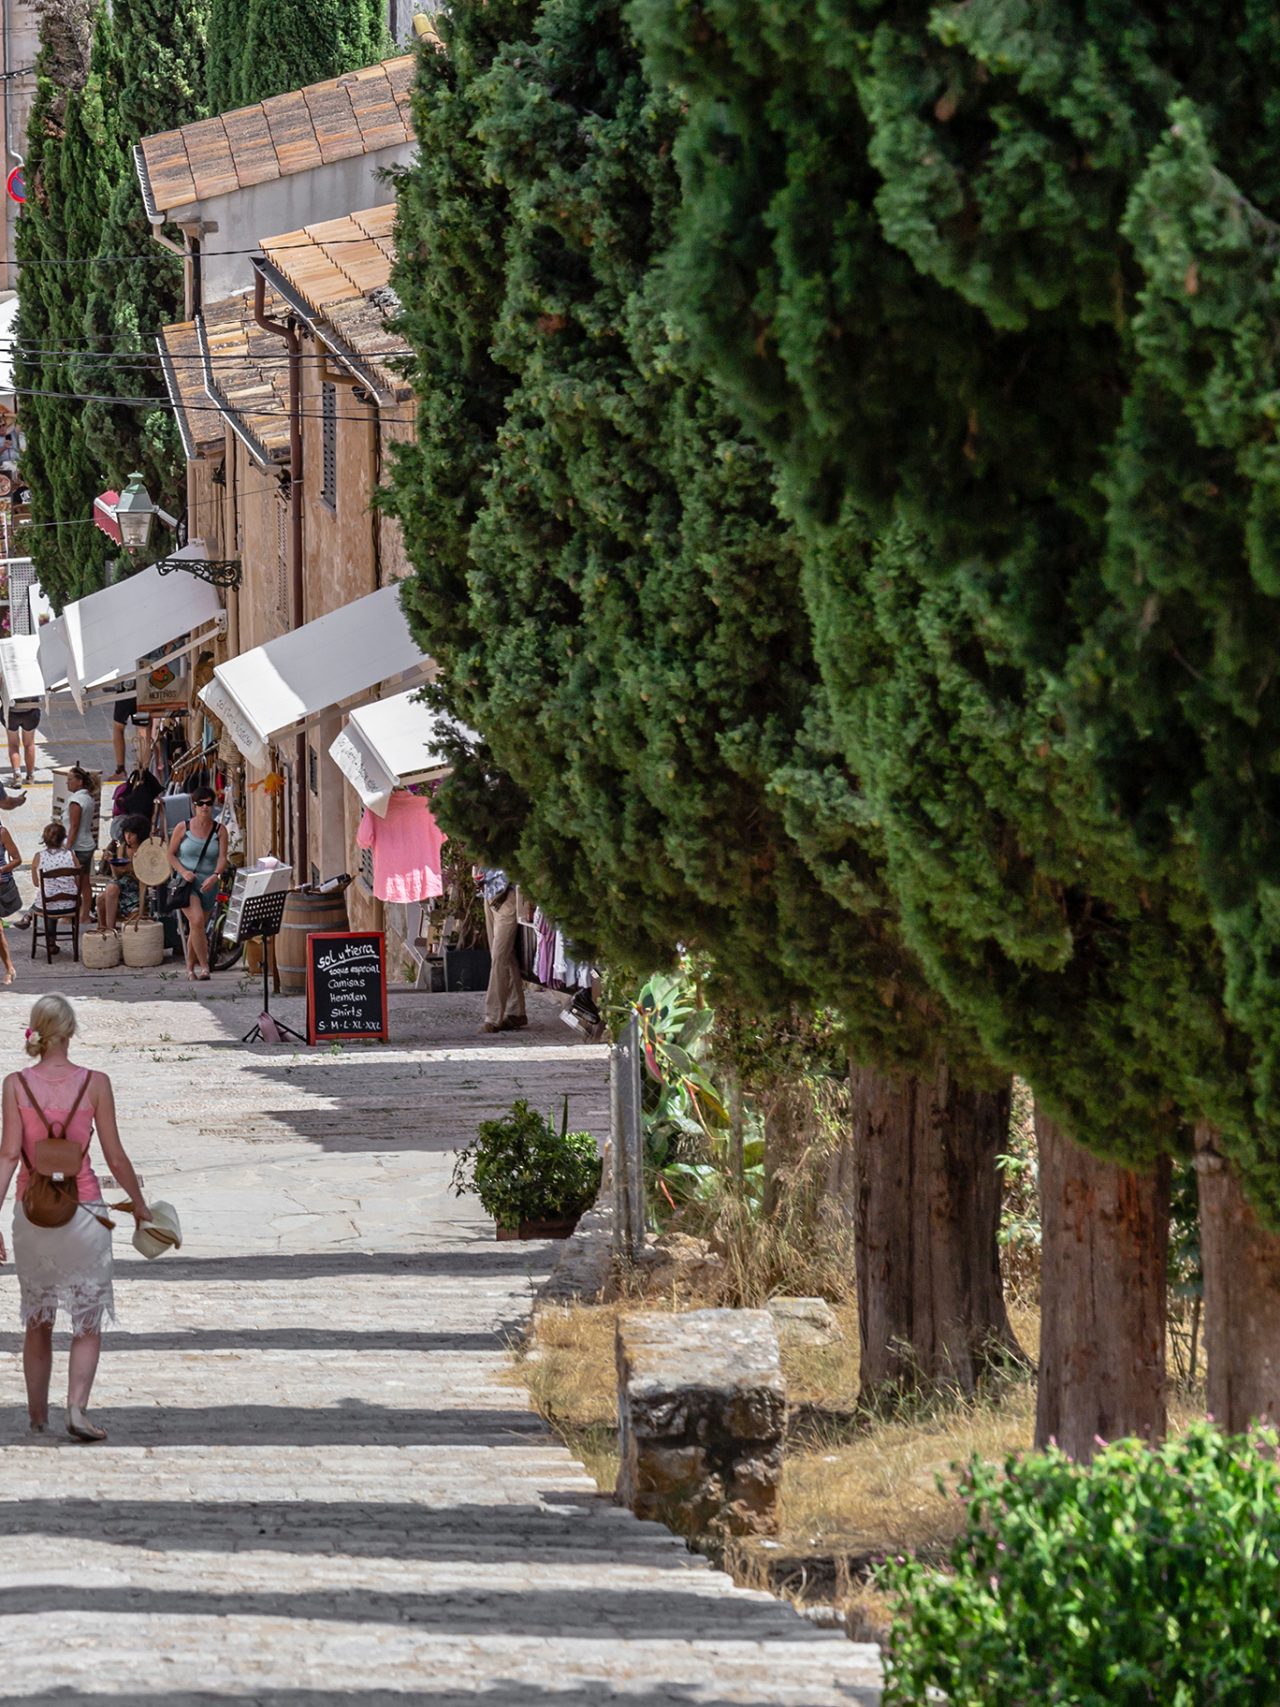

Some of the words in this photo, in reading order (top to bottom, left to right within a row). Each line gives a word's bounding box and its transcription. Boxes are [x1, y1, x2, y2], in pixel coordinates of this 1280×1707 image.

[317, 949, 337, 969] sol
[345, 944, 375, 957] tierra
[328, 978, 366, 989] Camisas
[330, 992, 367, 1002] Hemden
[330, 1006, 362, 1017] Shirts
